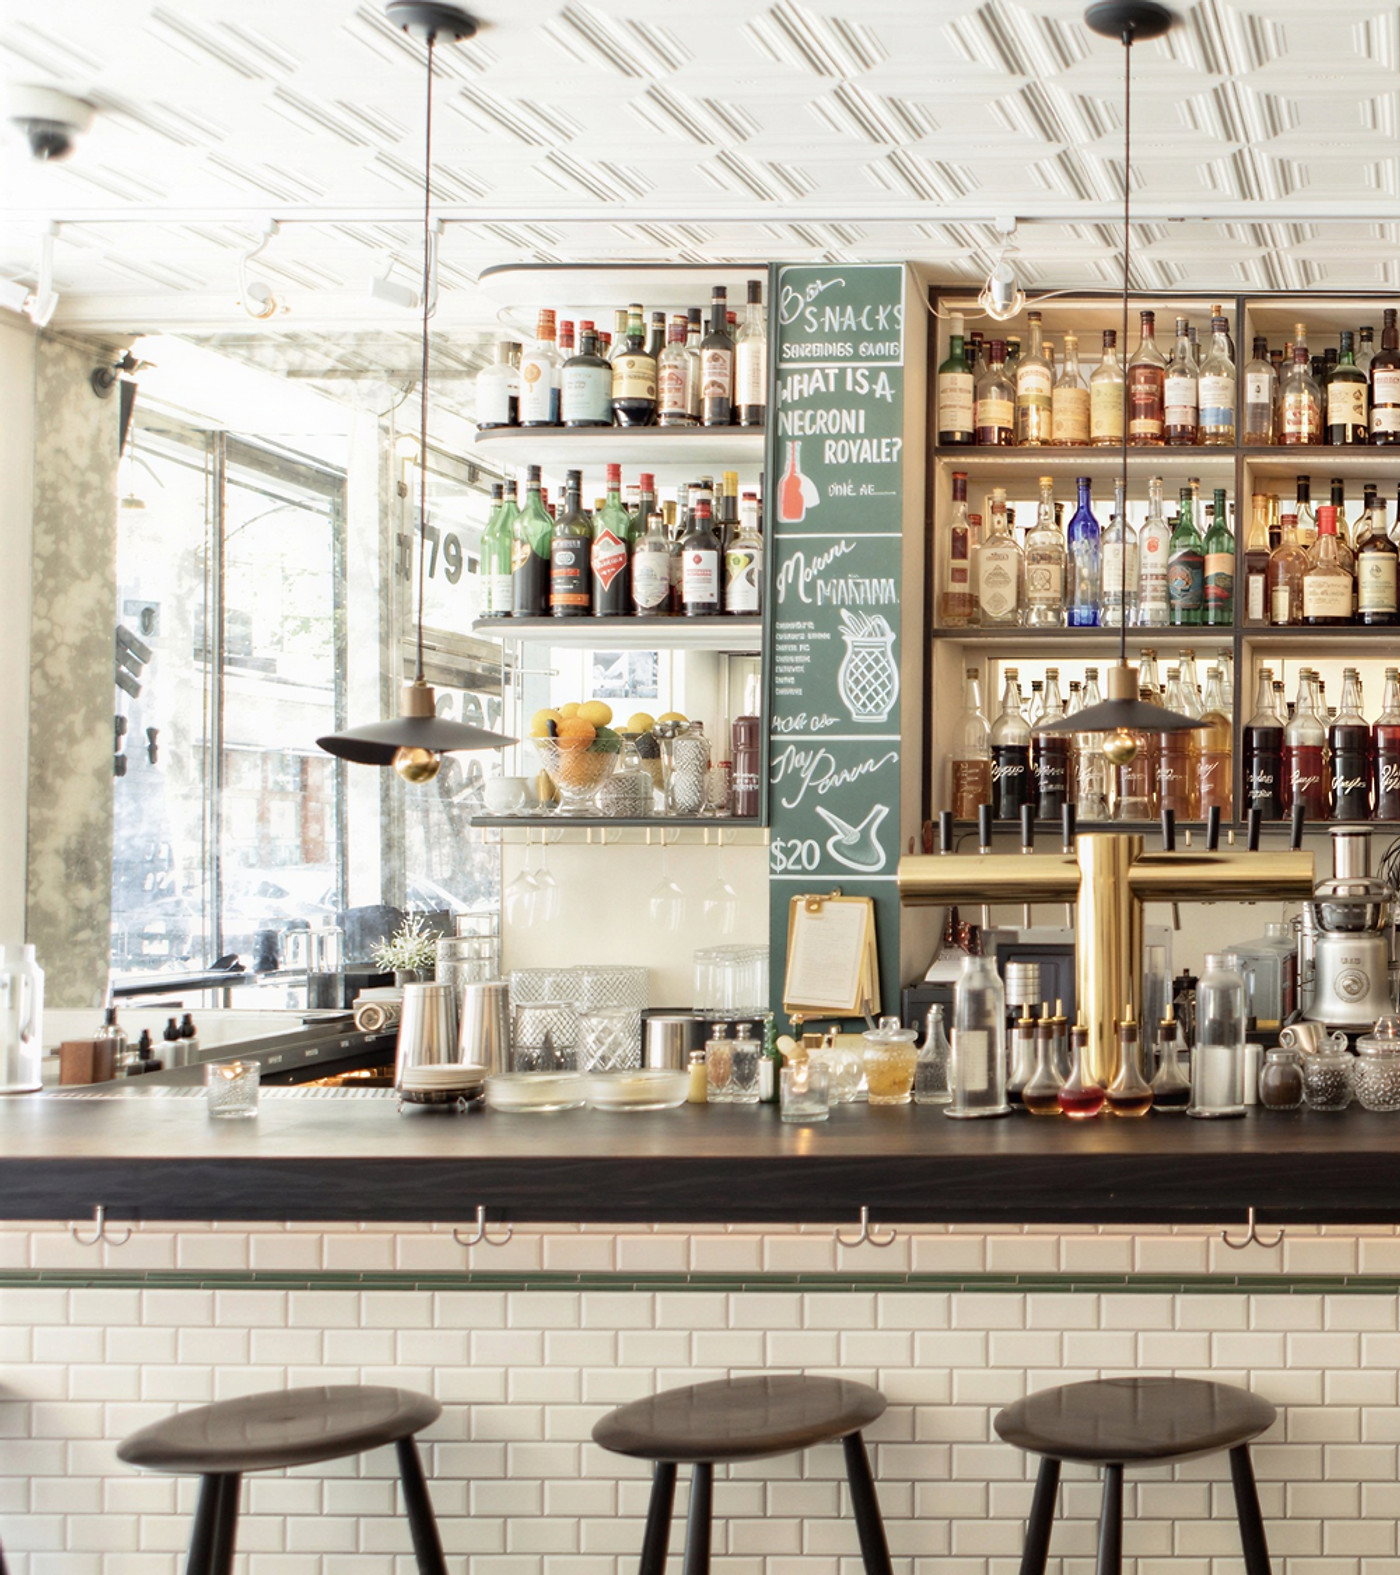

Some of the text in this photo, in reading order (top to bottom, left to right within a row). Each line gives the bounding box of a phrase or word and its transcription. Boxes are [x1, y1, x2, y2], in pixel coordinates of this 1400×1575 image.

[804, 304, 902, 333] SNACKS
[846, 368, 870, 395] IS
[873, 371, 896, 403] A
[824, 437, 903, 464] ROYALE?
[770, 837, 820, 873] $20
